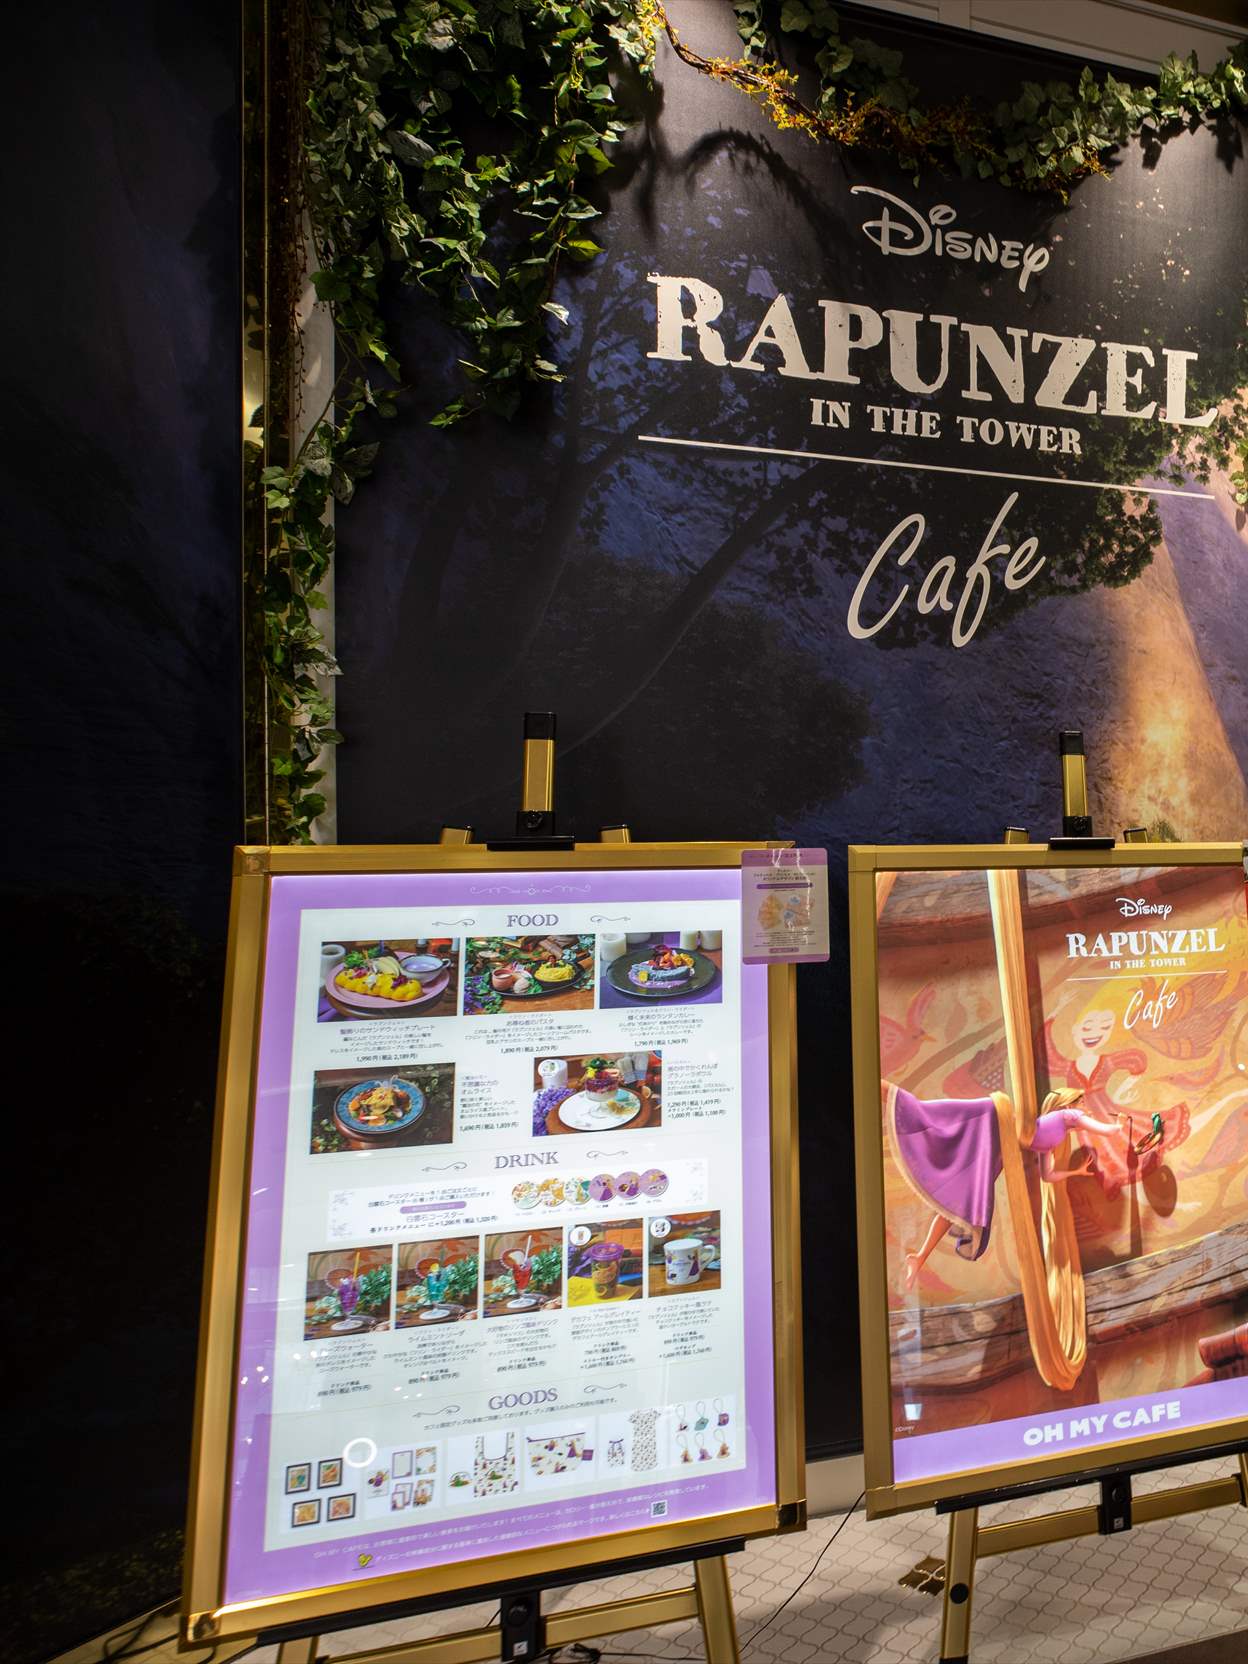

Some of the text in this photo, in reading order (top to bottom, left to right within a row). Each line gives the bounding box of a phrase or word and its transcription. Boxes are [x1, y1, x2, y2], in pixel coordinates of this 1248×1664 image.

[646, 271, 1218, 427] RAPUNZEL
[810, 399, 1081, 455] IN THE TOWER
[507, 914, 559, 927] FOOD
[1065, 927, 1226, 958] RAPUNZEL
[1110, 957, 1186, 970] IN THE TOWER
[495, 1151, 560, 1169] DRINK
[488, 1388, 558, 1410] GOODS
[1023, 1400, 1181, 1446] OH MY CAFE
